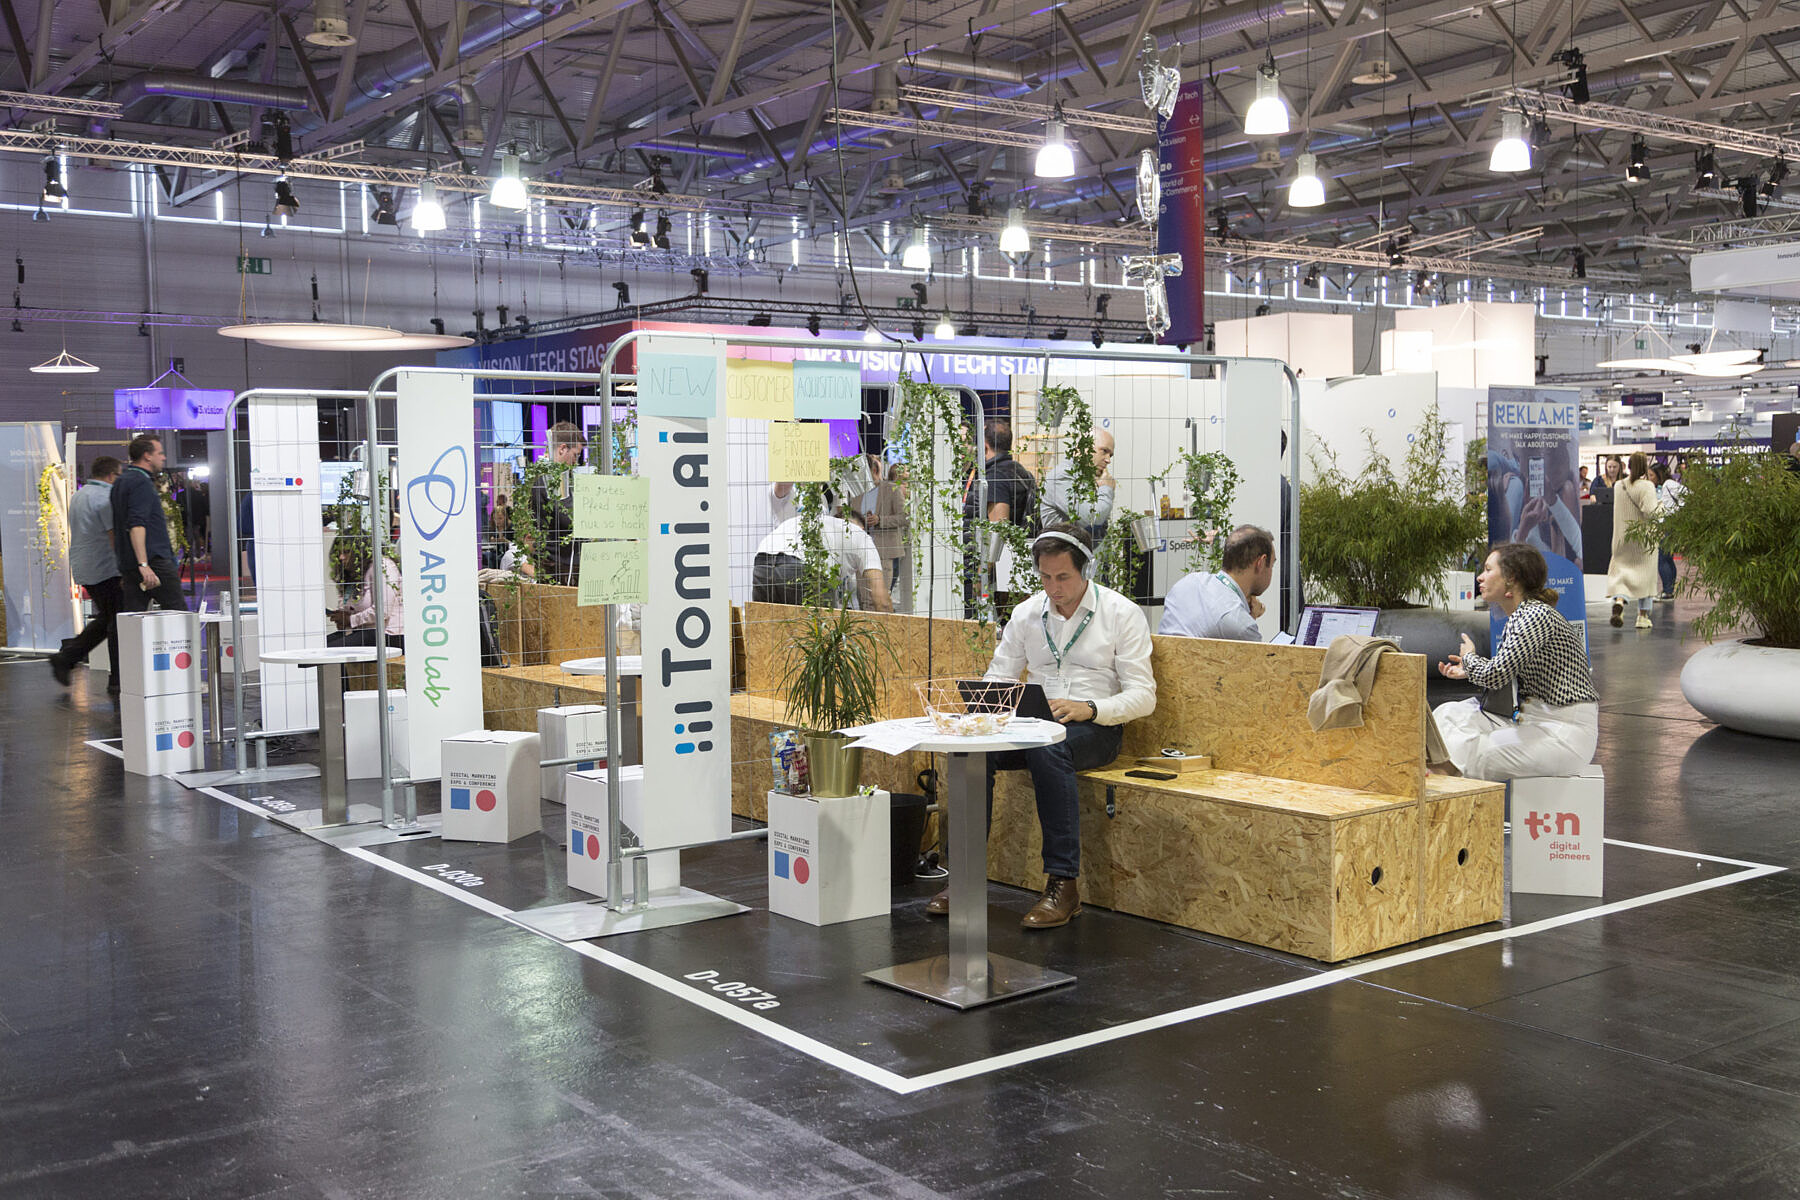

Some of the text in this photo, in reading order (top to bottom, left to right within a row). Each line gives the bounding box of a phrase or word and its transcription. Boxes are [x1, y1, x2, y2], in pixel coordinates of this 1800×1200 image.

[529, 349, 566, 372] TECH
[940, 353, 996, 375] TECH
[651, 366, 714, 397] NEW
[727, 374, 792, 402] CUSTOMER
[784, 439, 821, 457] FINTECH
[784, 459, 822, 478] BANKING
[604, 520, 615, 529] so
[1556, 577, 1574, 585] MAKE
[423, 655, 451, 708] lab
[774, 831, 810, 846] DIGITAL MARKETING
[774, 840, 783, 848] EXPO
[788, 844, 810, 855] CONFERENCE
[1549, 841, 1580, 852] digital
[1549, 851, 1591, 861] pioneers
[683, 969, 781, 1010] D-057a
